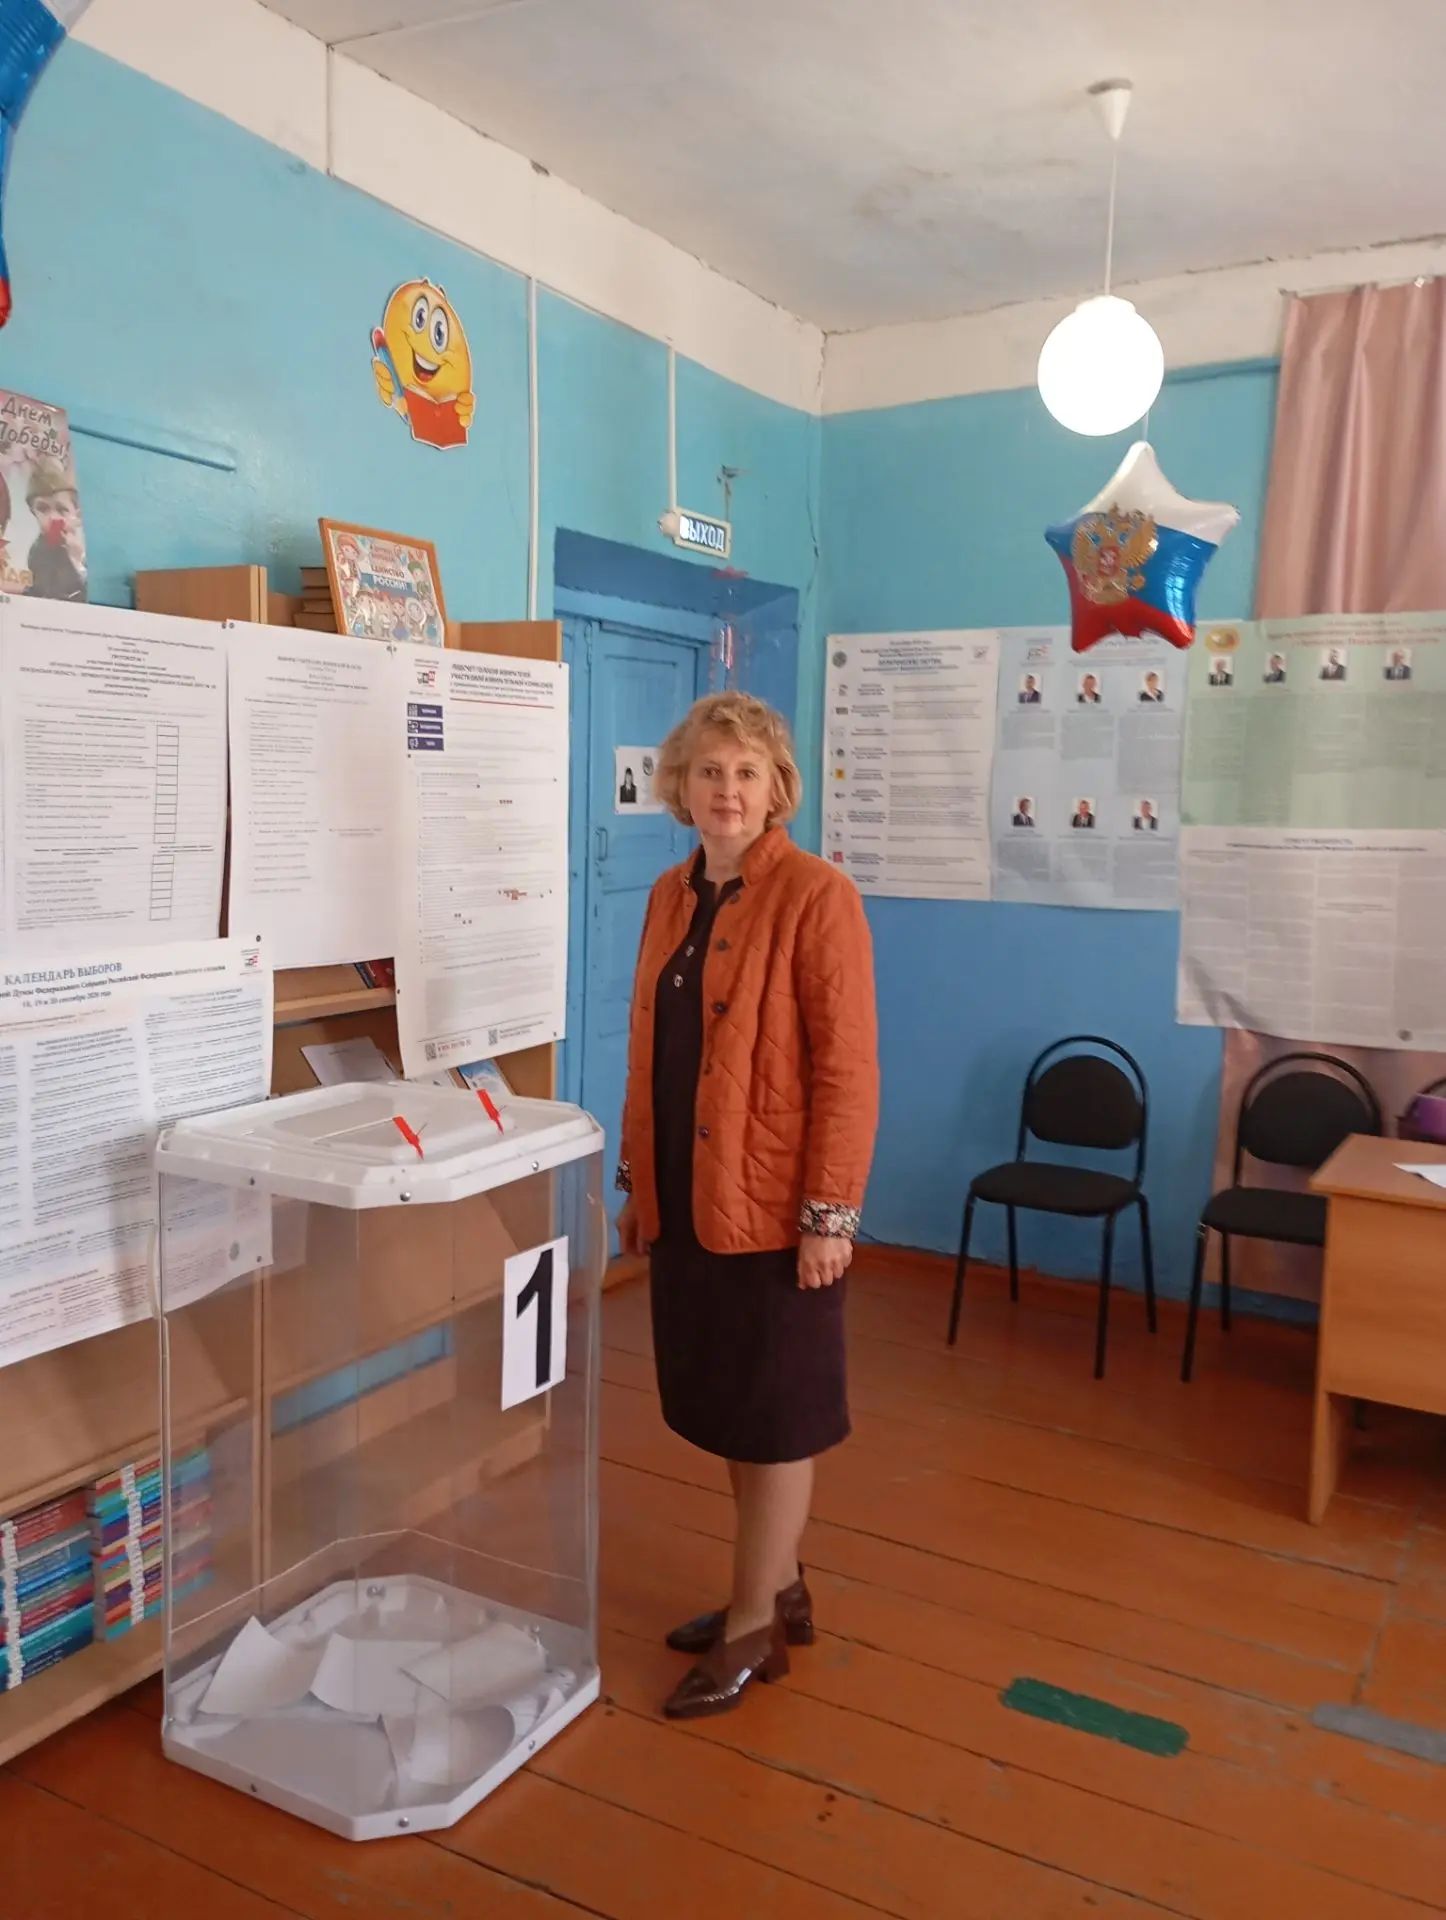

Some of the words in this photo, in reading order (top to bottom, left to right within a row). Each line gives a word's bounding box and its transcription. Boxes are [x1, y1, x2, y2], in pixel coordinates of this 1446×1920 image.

[1, 397, 51, 426] Днем
[4, 968, 76, 985] КАЛЕНДАРЬ
[77, 962, 123, 978] ВЫБОРОВ
[516, 1248, 553, 1388] 1
